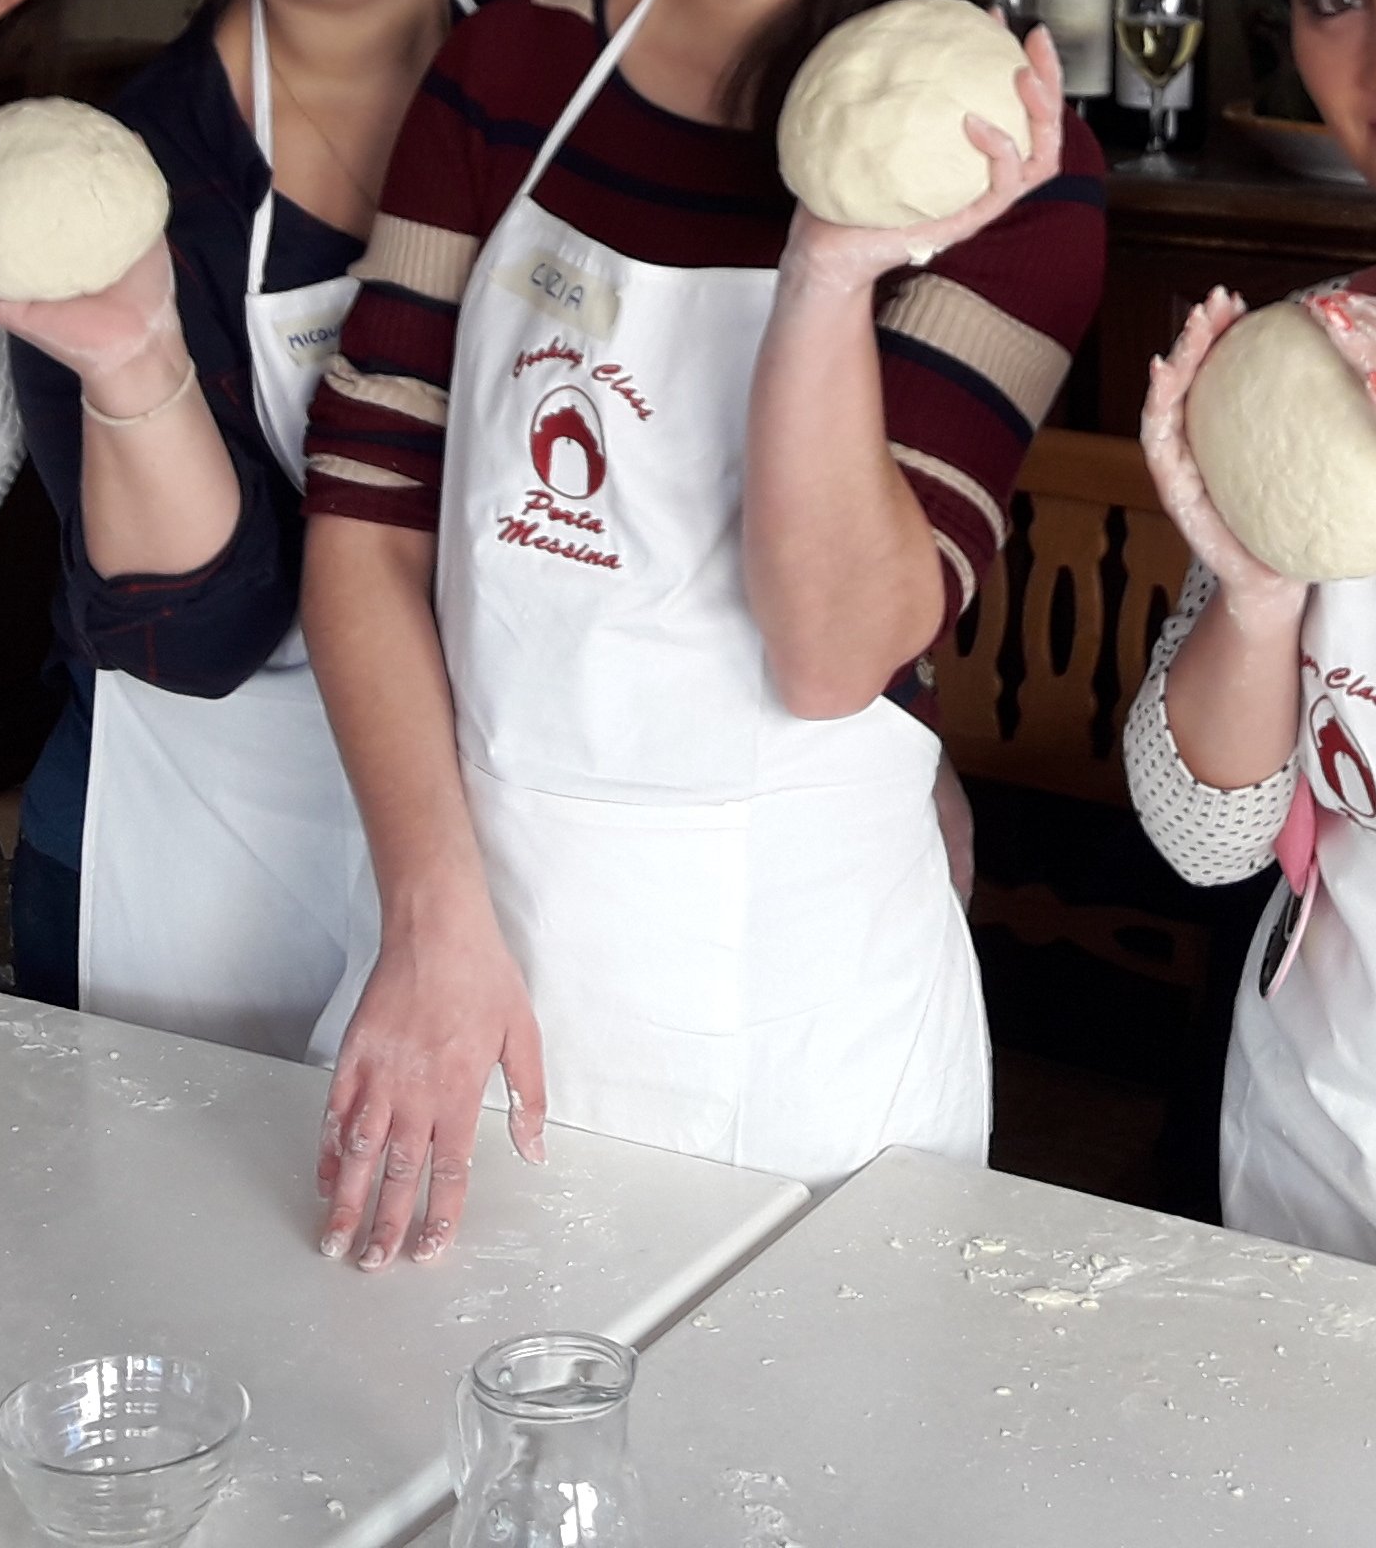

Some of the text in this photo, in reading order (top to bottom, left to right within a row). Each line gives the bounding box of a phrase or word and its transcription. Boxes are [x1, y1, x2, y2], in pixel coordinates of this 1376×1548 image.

[591, 363, 655, 421] Class
[521, 490, 605, 534] Porta
[497, 515, 622, 570] Messina
